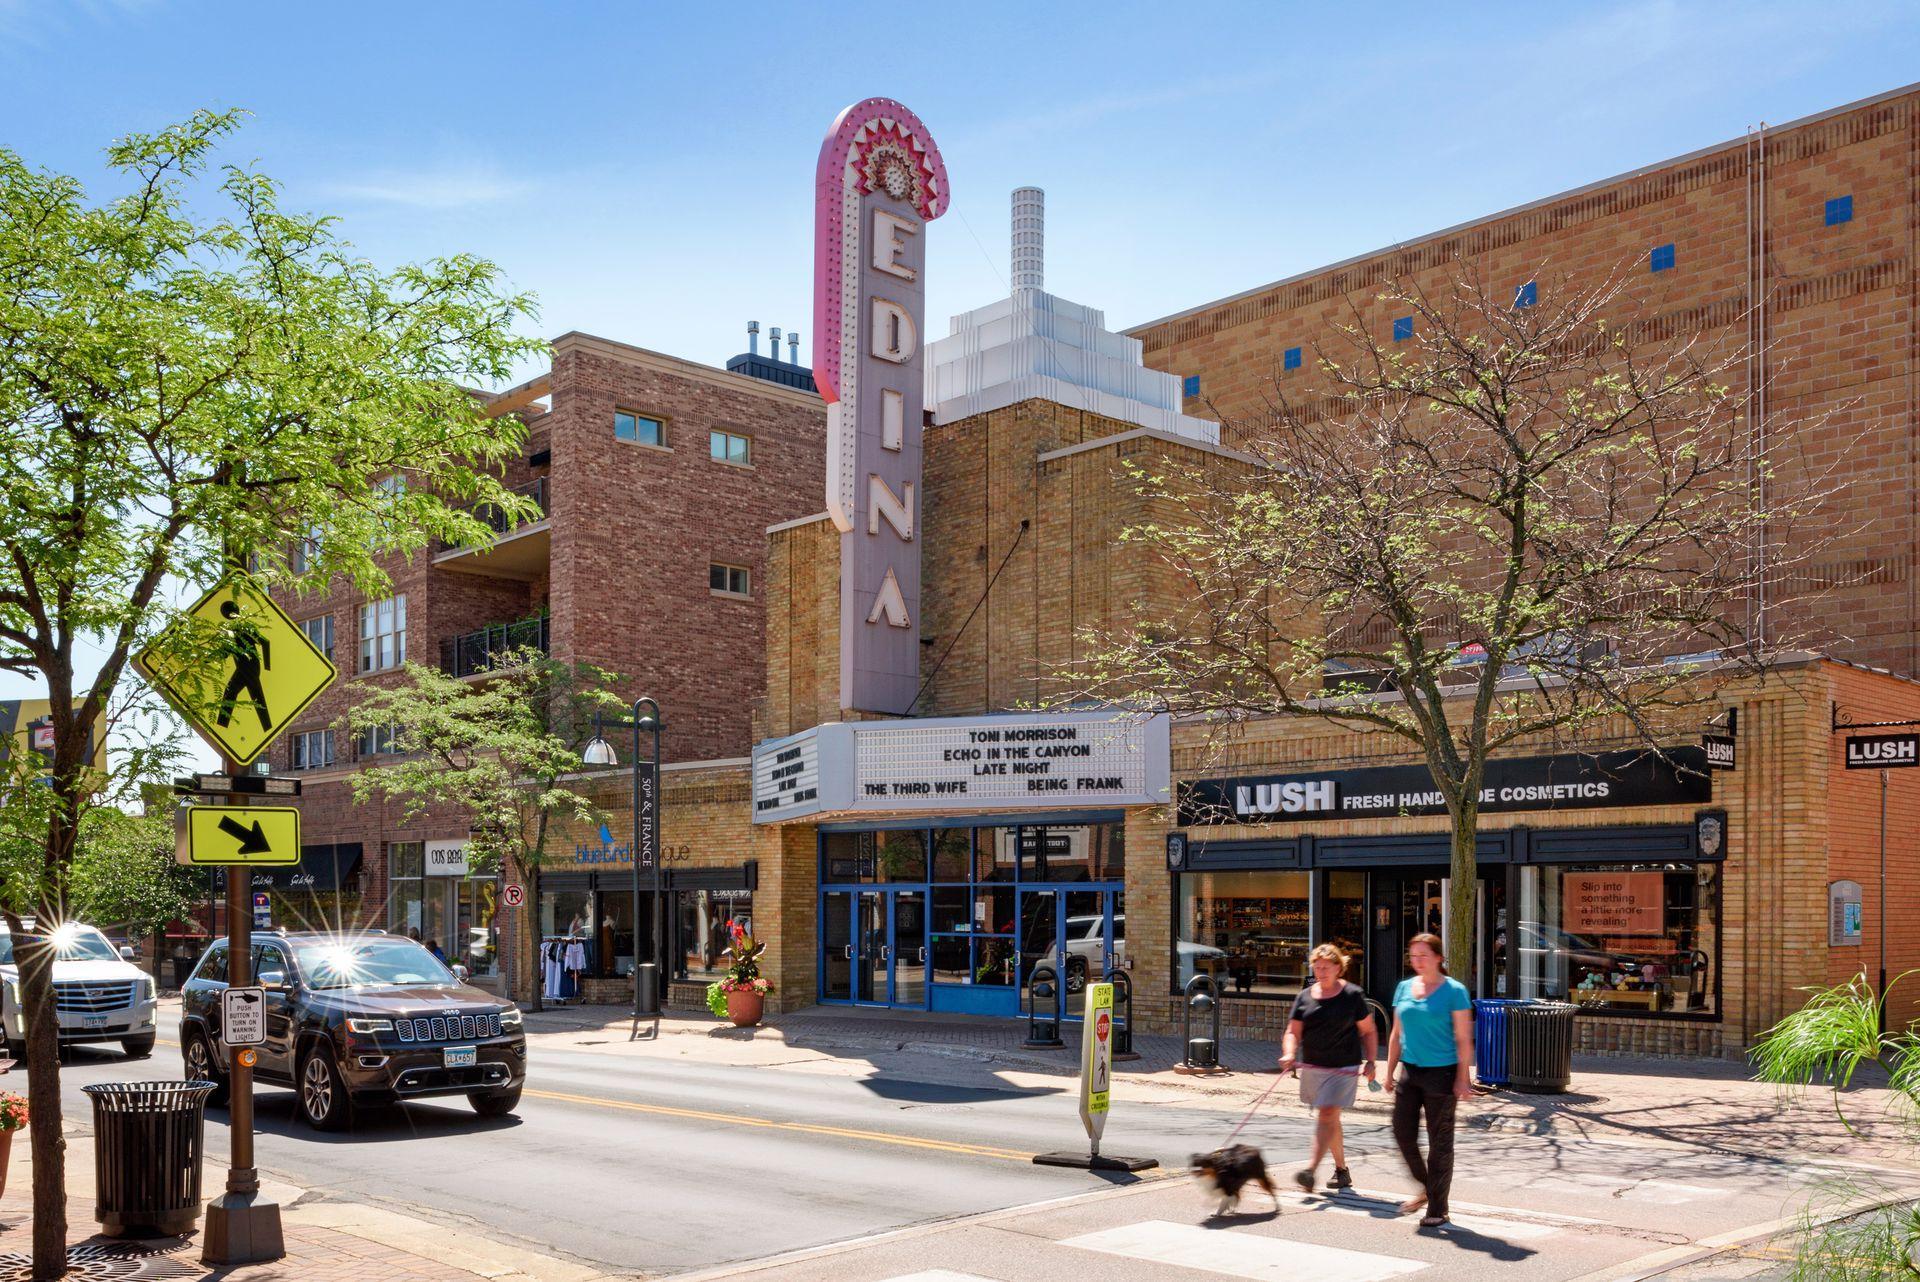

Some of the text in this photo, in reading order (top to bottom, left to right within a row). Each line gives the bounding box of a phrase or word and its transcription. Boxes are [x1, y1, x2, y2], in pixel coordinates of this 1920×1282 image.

[867, 207, 918, 629] EDINA
[969, 728, 1077, 743] TONI MORRISON
[943, 744, 1090, 761] ECHO IN THE CANYON
[1706, 742, 1734, 761] LUSH
[1849, 740, 1916, 761] LUSH
[973, 762, 1050, 775] LATE NIGHT
[864, 781, 968, 795] THE THIRD WIFE
[1027, 776, 1124, 791] BEING FRANK
[1236, 780, 1610, 815] LUSH FRESH HANDDE COSMETICS
[641, 777, 653, 867] 50th & FRANCE
[431, 849, 463, 865] COS BAR
[1581, 881, 1623, 893] Slip into
[510, 889, 520, 901] P
[1581, 893, 1636, 905] something
[1590, 904, 1612, 914] little
[1615, 906, 1643, 915] more
[1097, 987, 1111, 997] STATE
[1099, 997, 1109, 1006] LAW
[1097, 1022, 1109, 1035] STOP
